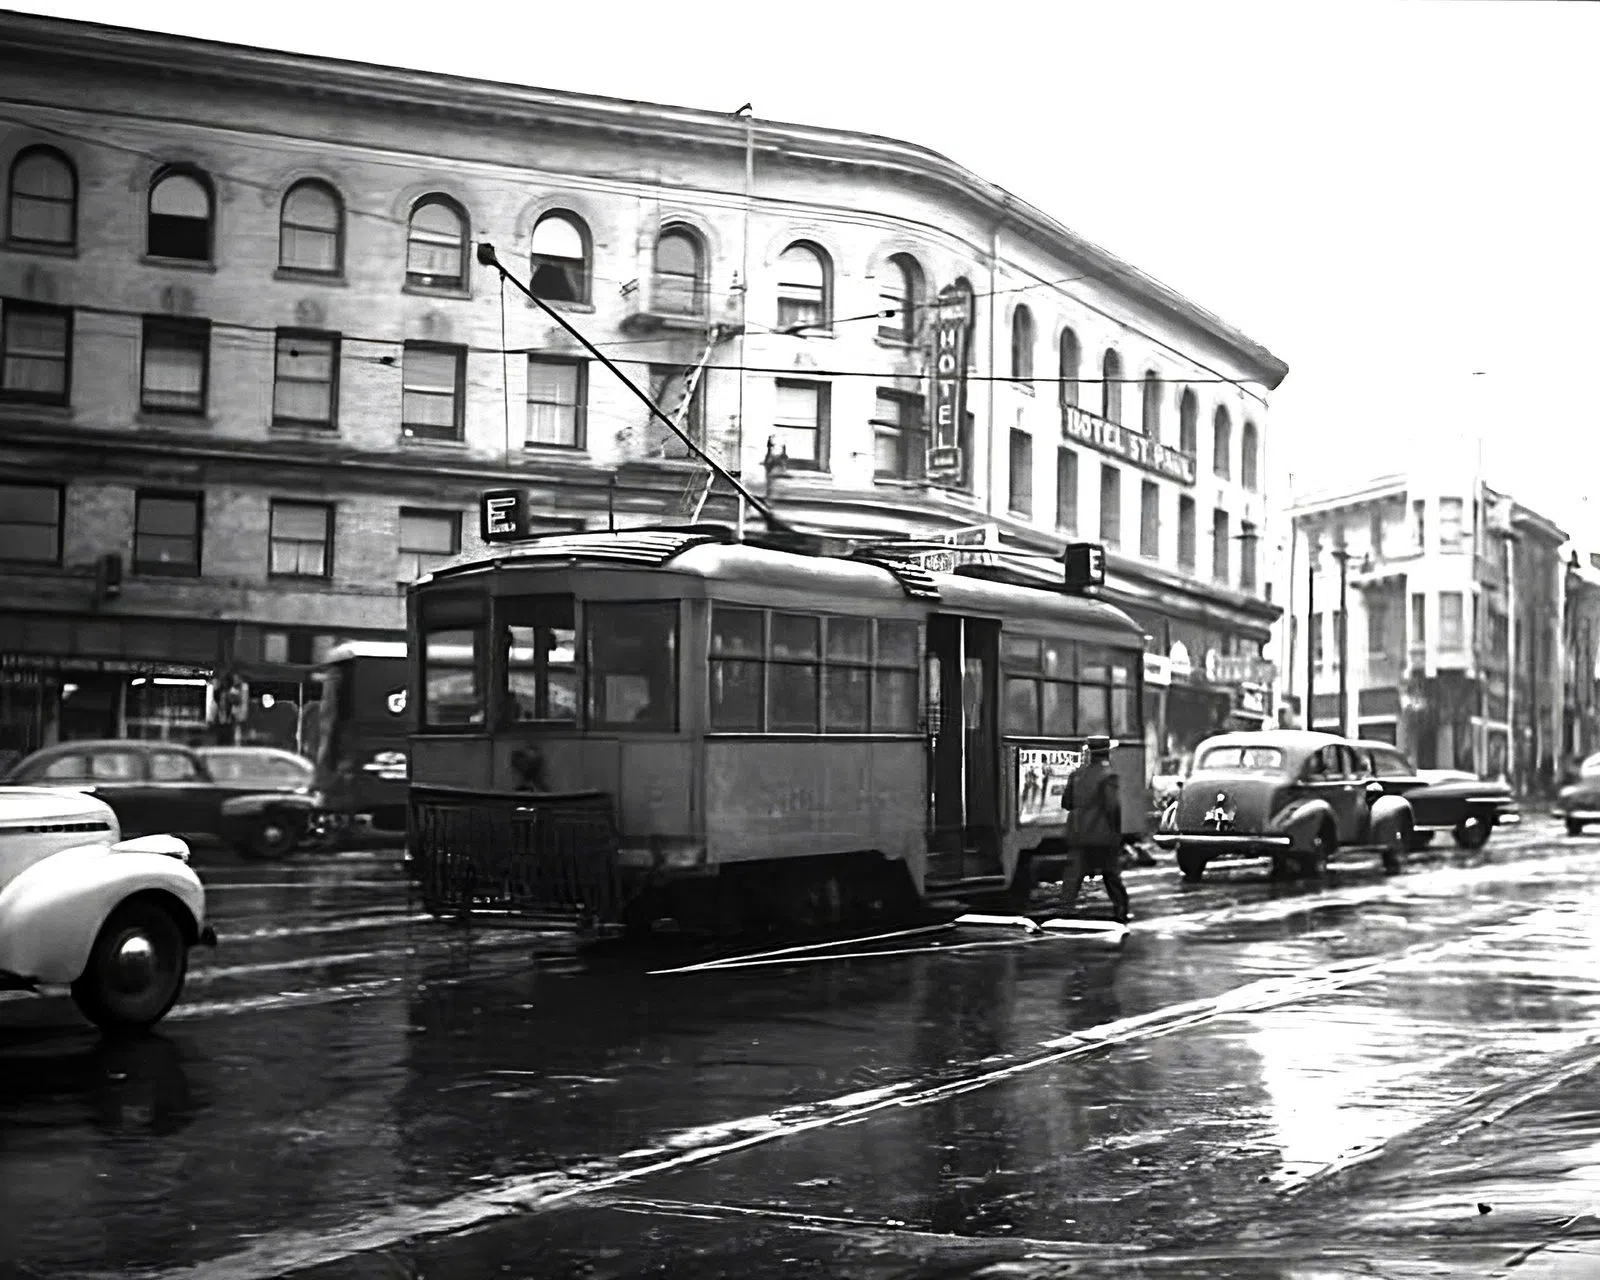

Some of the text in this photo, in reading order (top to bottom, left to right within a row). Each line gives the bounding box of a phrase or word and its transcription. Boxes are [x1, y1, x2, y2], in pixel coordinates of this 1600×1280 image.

[938, 328, 956, 450] HOTEL
[1066, 407, 1126, 454] HOTEL
[487, 497, 516, 534] E
[1089, 548, 1102, 578] E
